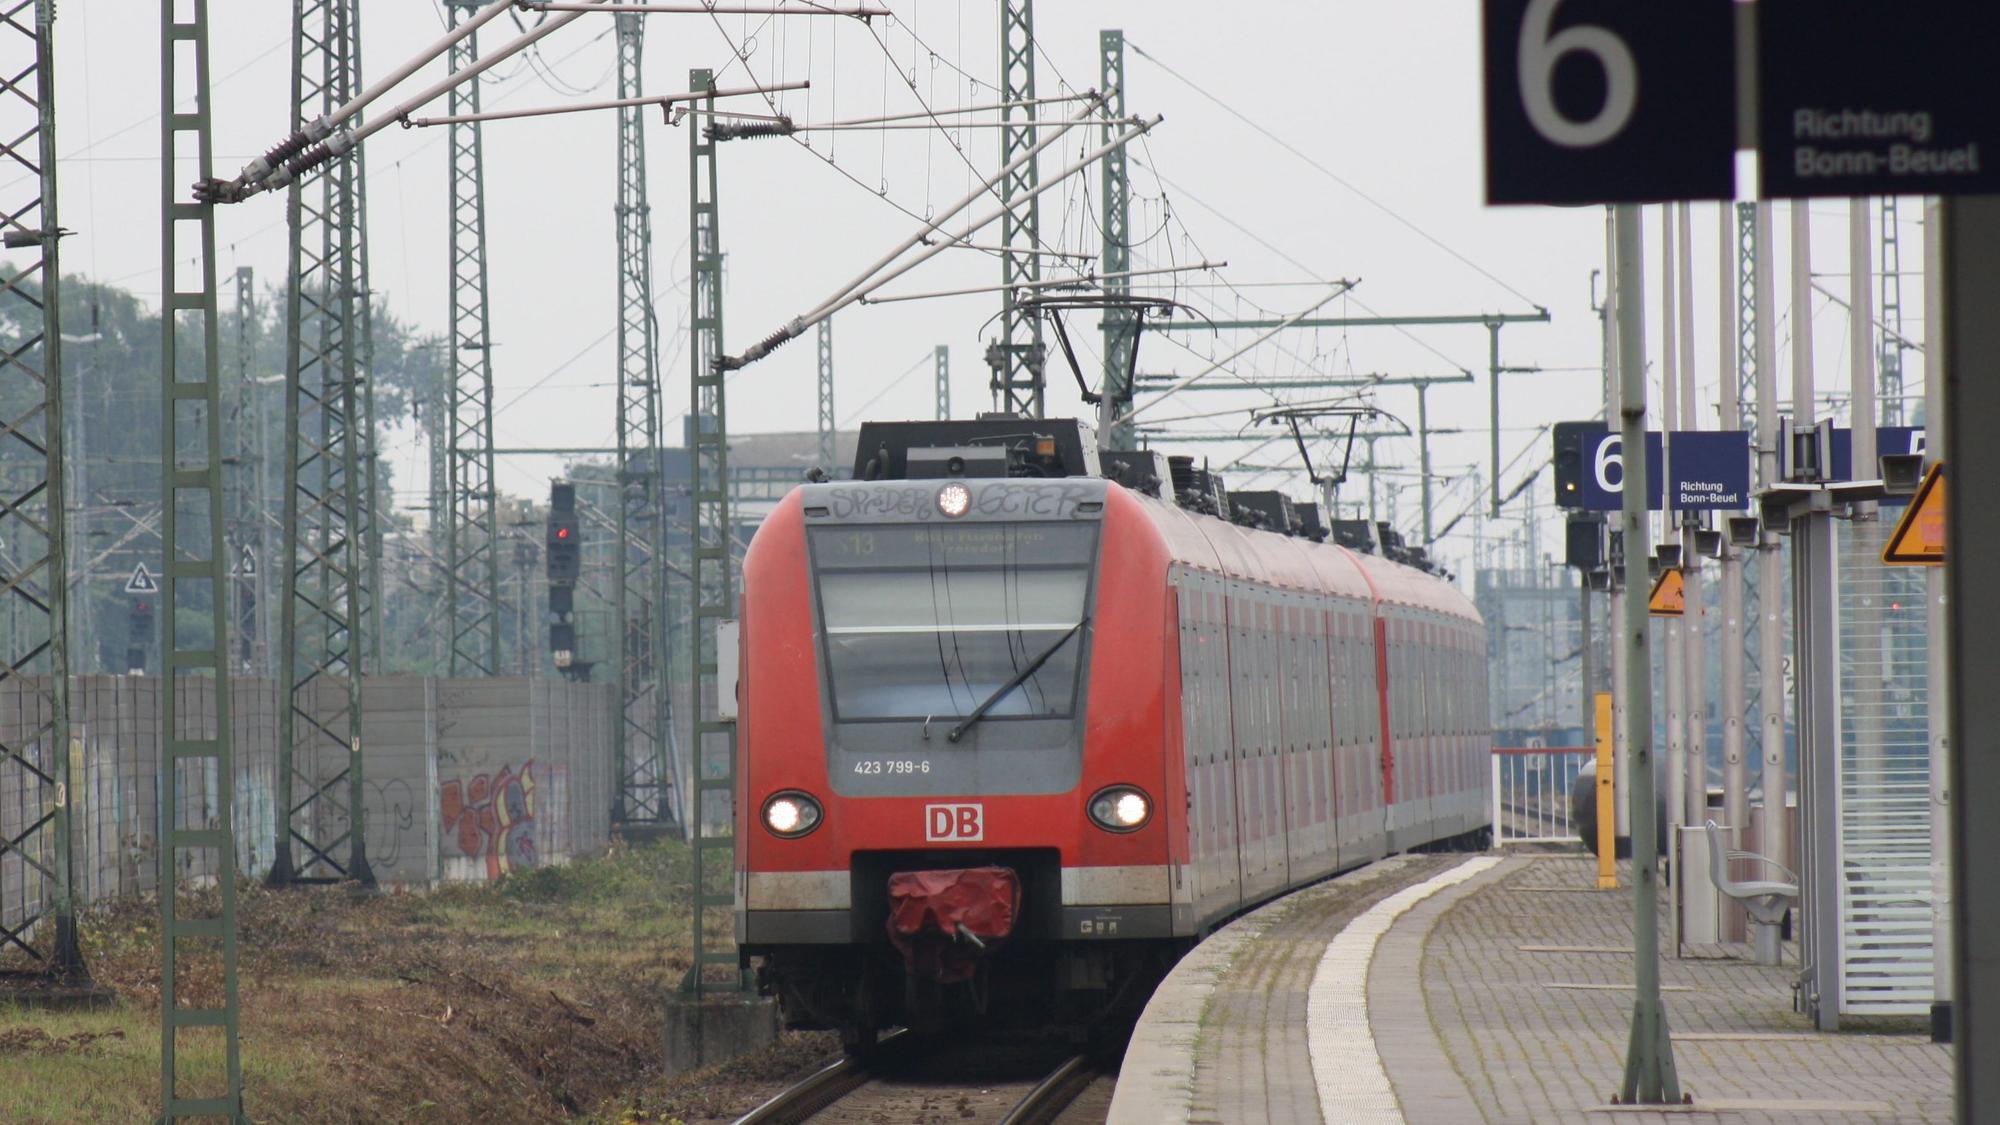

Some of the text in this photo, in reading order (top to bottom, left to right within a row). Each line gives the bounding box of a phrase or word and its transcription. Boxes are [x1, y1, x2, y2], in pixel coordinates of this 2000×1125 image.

[1518, 0, 1637, 147] 6
[1794, 108, 1931, 140] Richtung
[1795, 144, 1979, 176] Bonn-Beuel
[1595, 434, 1623, 492] 6
[1681, 482, 1723, 493] Richtung
[1681, 493, 1737, 503] Bonn-Beuel
[854, 760, 930, 774] 423 799-6
[930, 806, 980, 839] DB
